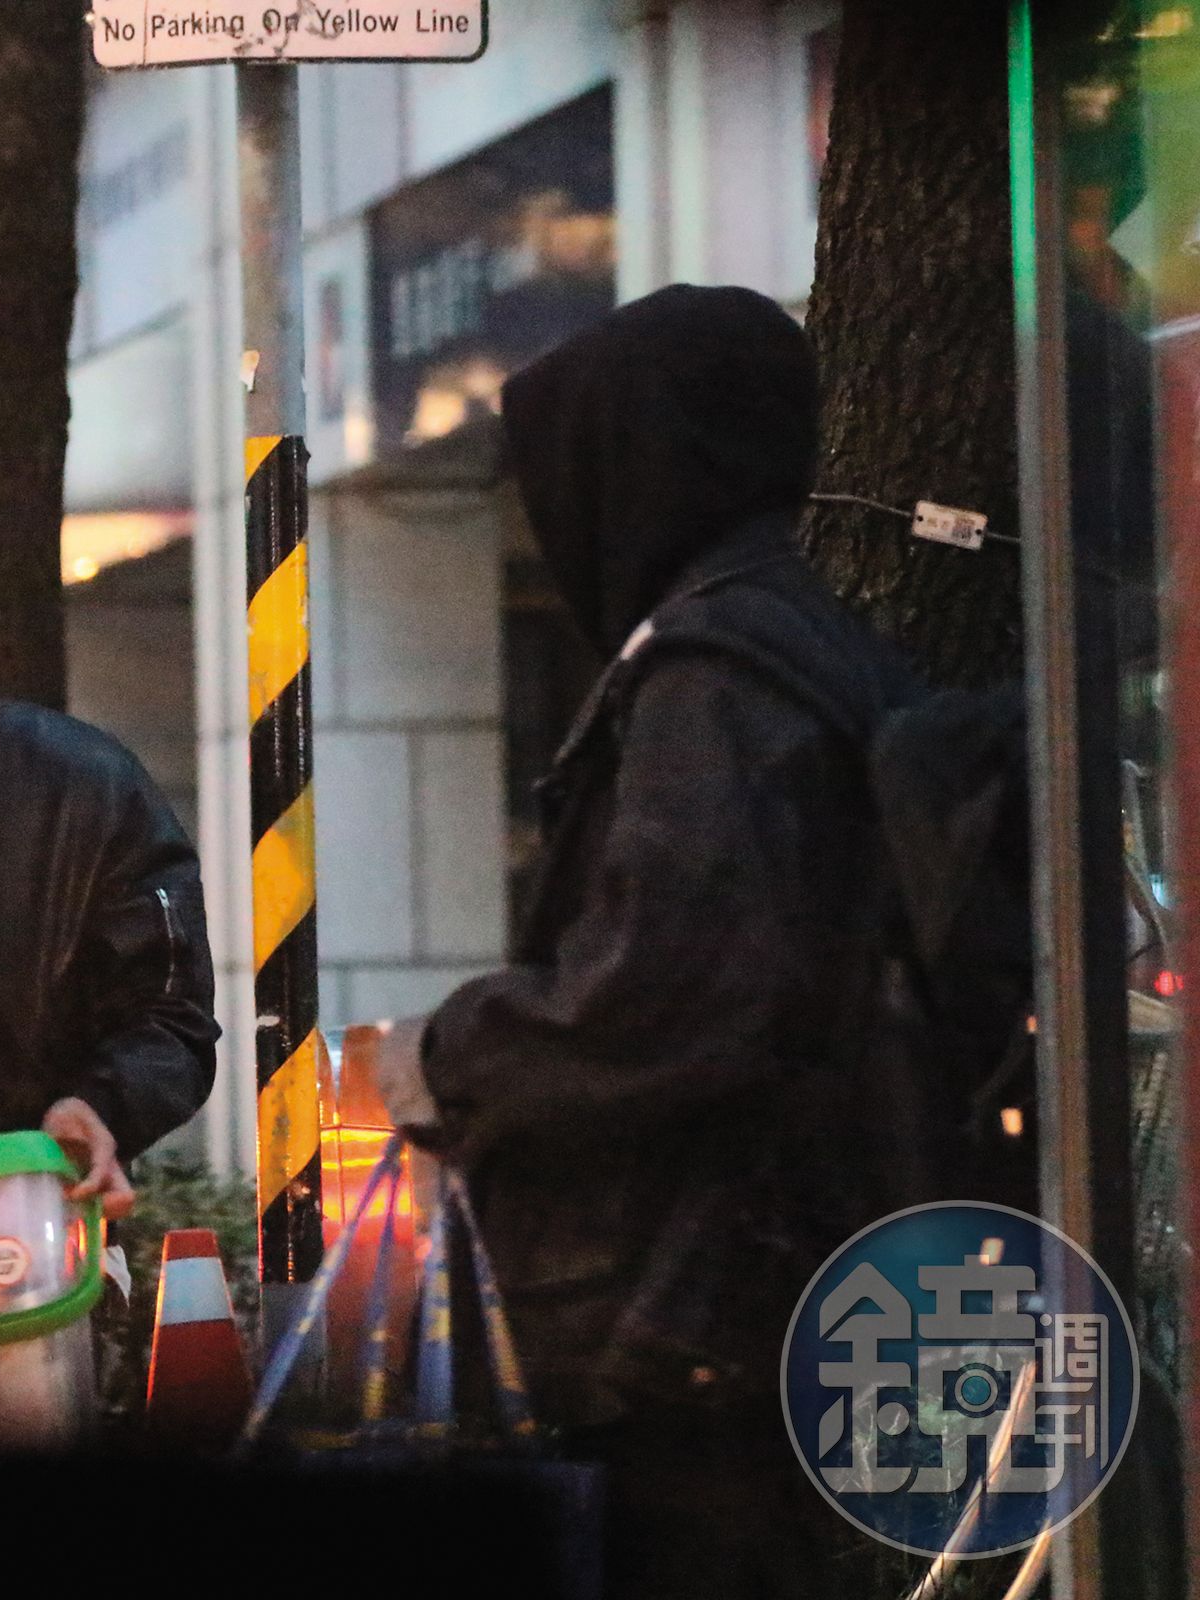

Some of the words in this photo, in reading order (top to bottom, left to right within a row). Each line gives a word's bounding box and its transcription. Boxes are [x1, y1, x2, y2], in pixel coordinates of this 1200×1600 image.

[102, 16, 136, 43] No
[150, 11, 245, 39] Parking
[261, 8, 299, 34] On
[316, 8, 399, 34] Yellow
[415, 8, 470, 34] Line
